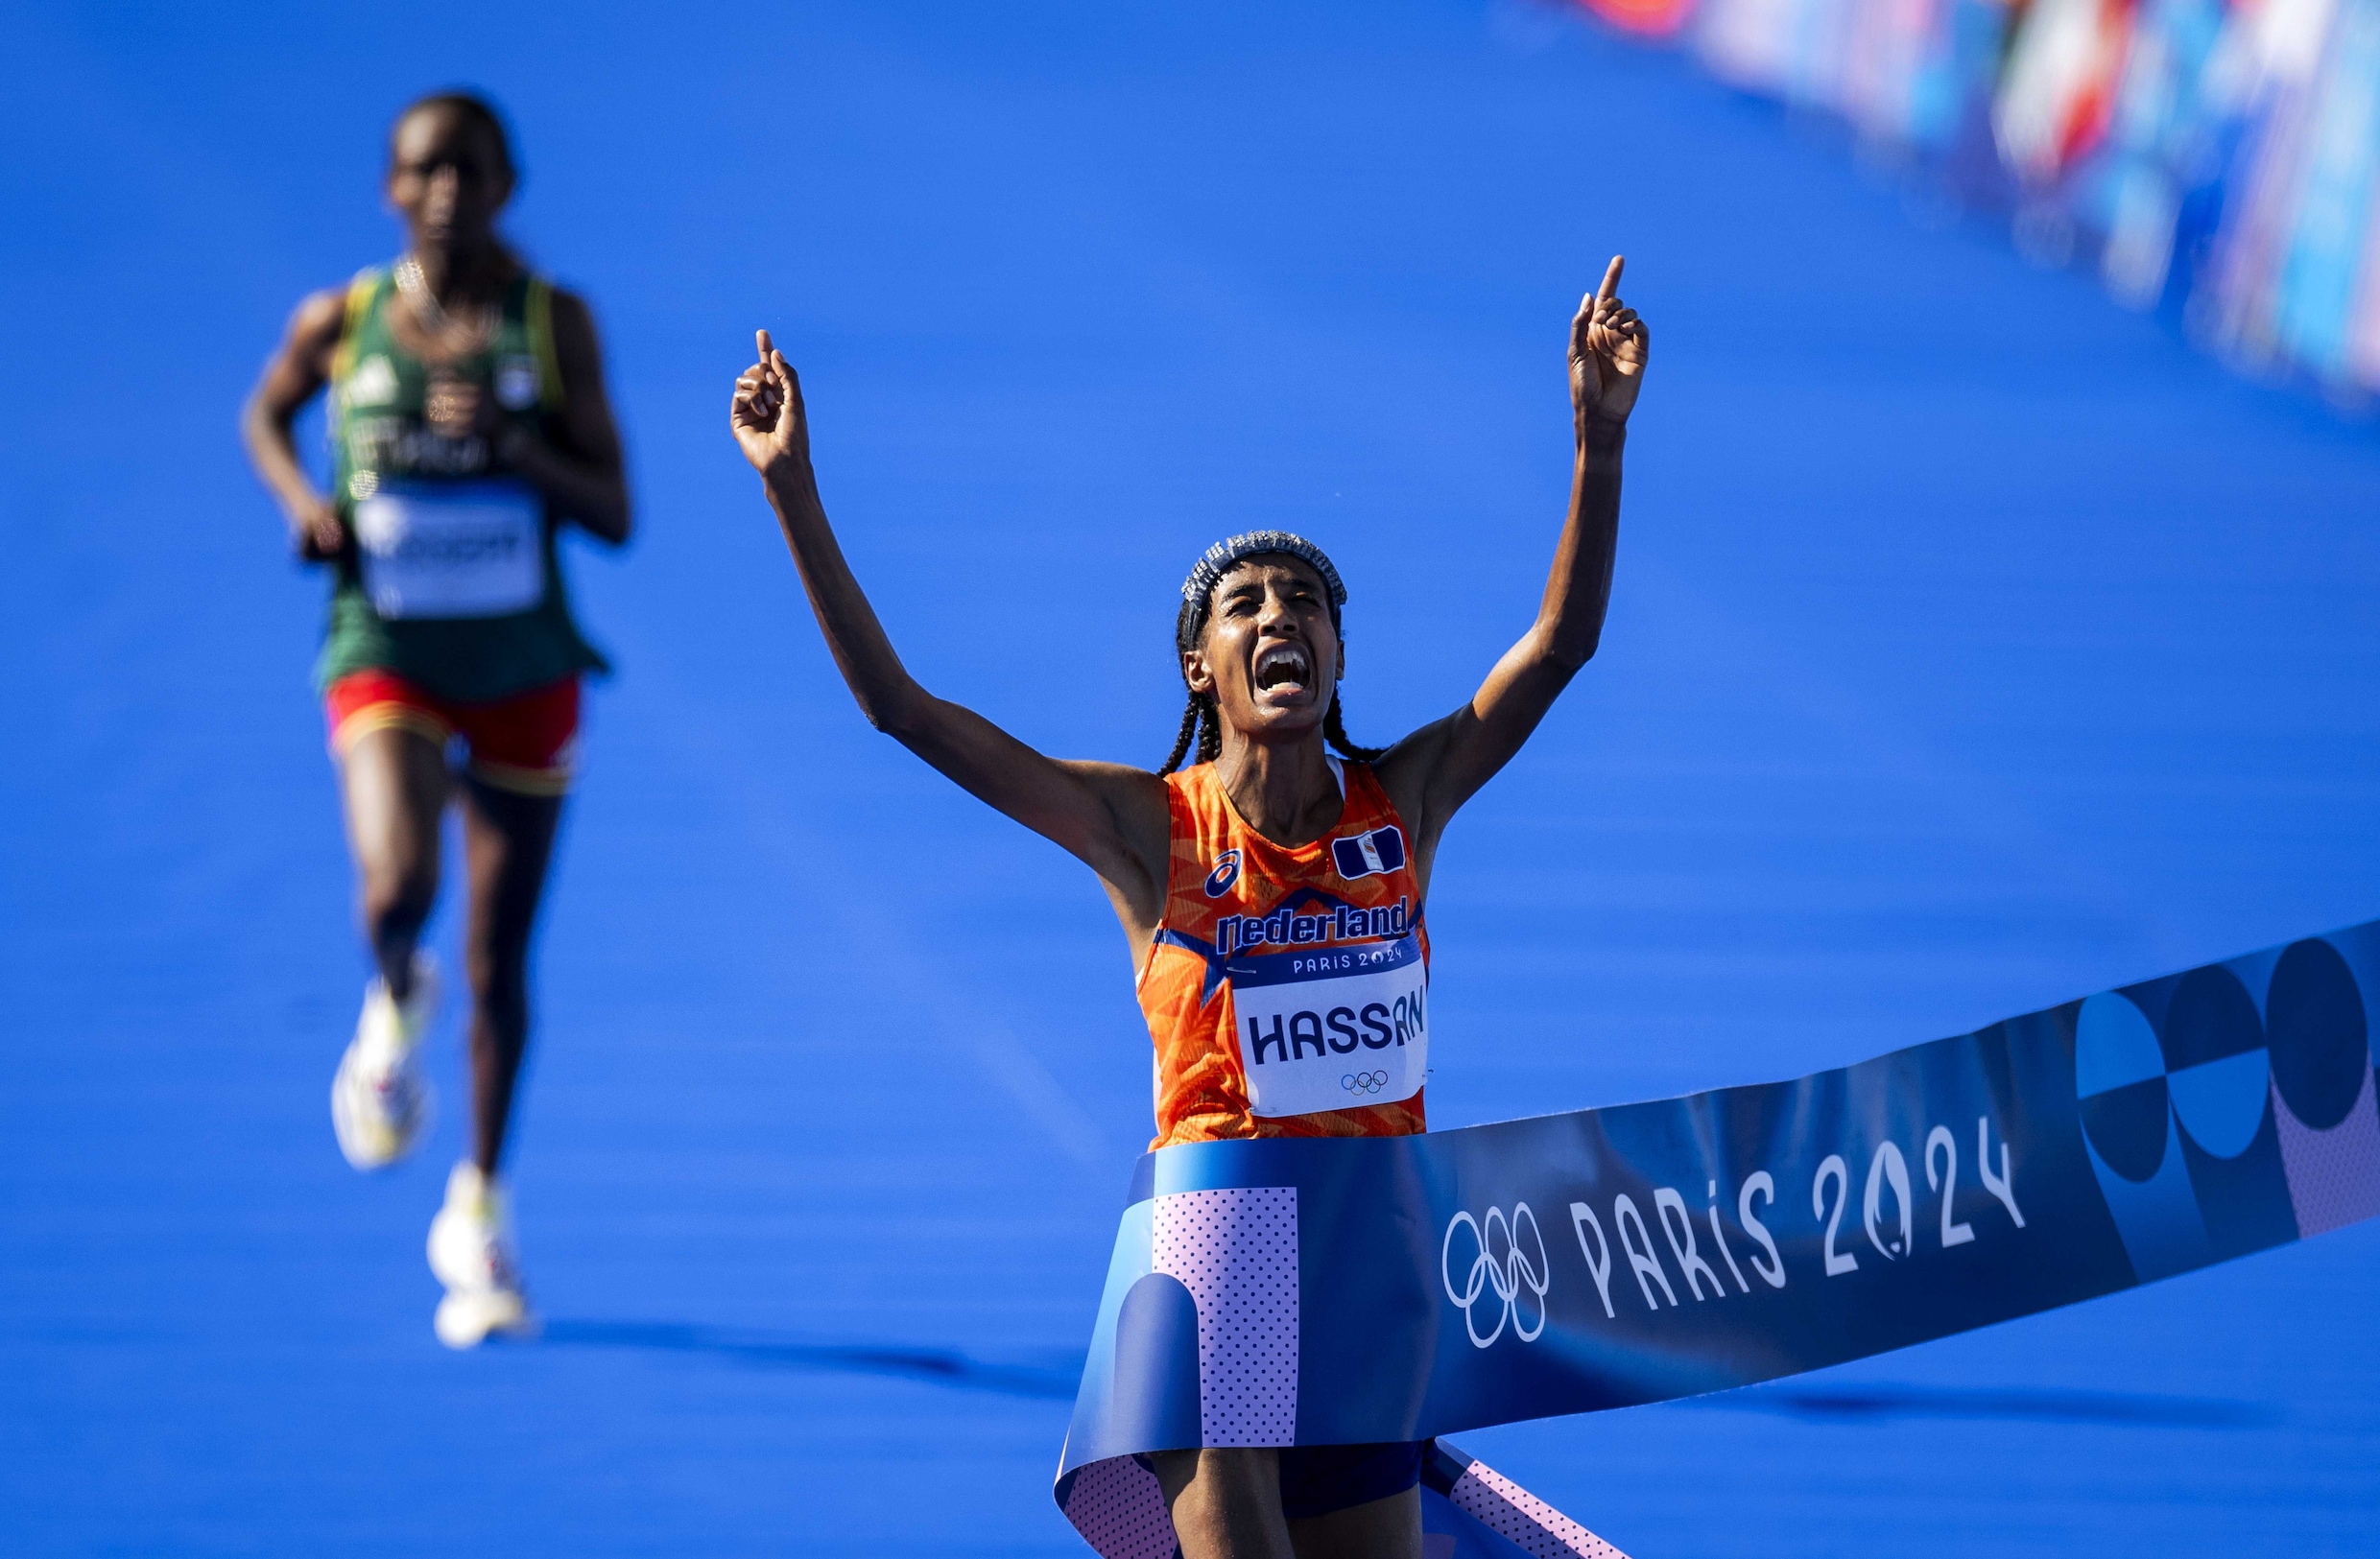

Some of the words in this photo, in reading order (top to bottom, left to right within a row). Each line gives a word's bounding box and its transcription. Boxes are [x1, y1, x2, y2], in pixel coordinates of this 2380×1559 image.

[1216, 895, 1408, 955] nederland
[1358, 947, 1402, 967] 2024
[1248, 984, 1424, 1066] HASSAN
[1813, 1116, 2026, 1277] 2024
